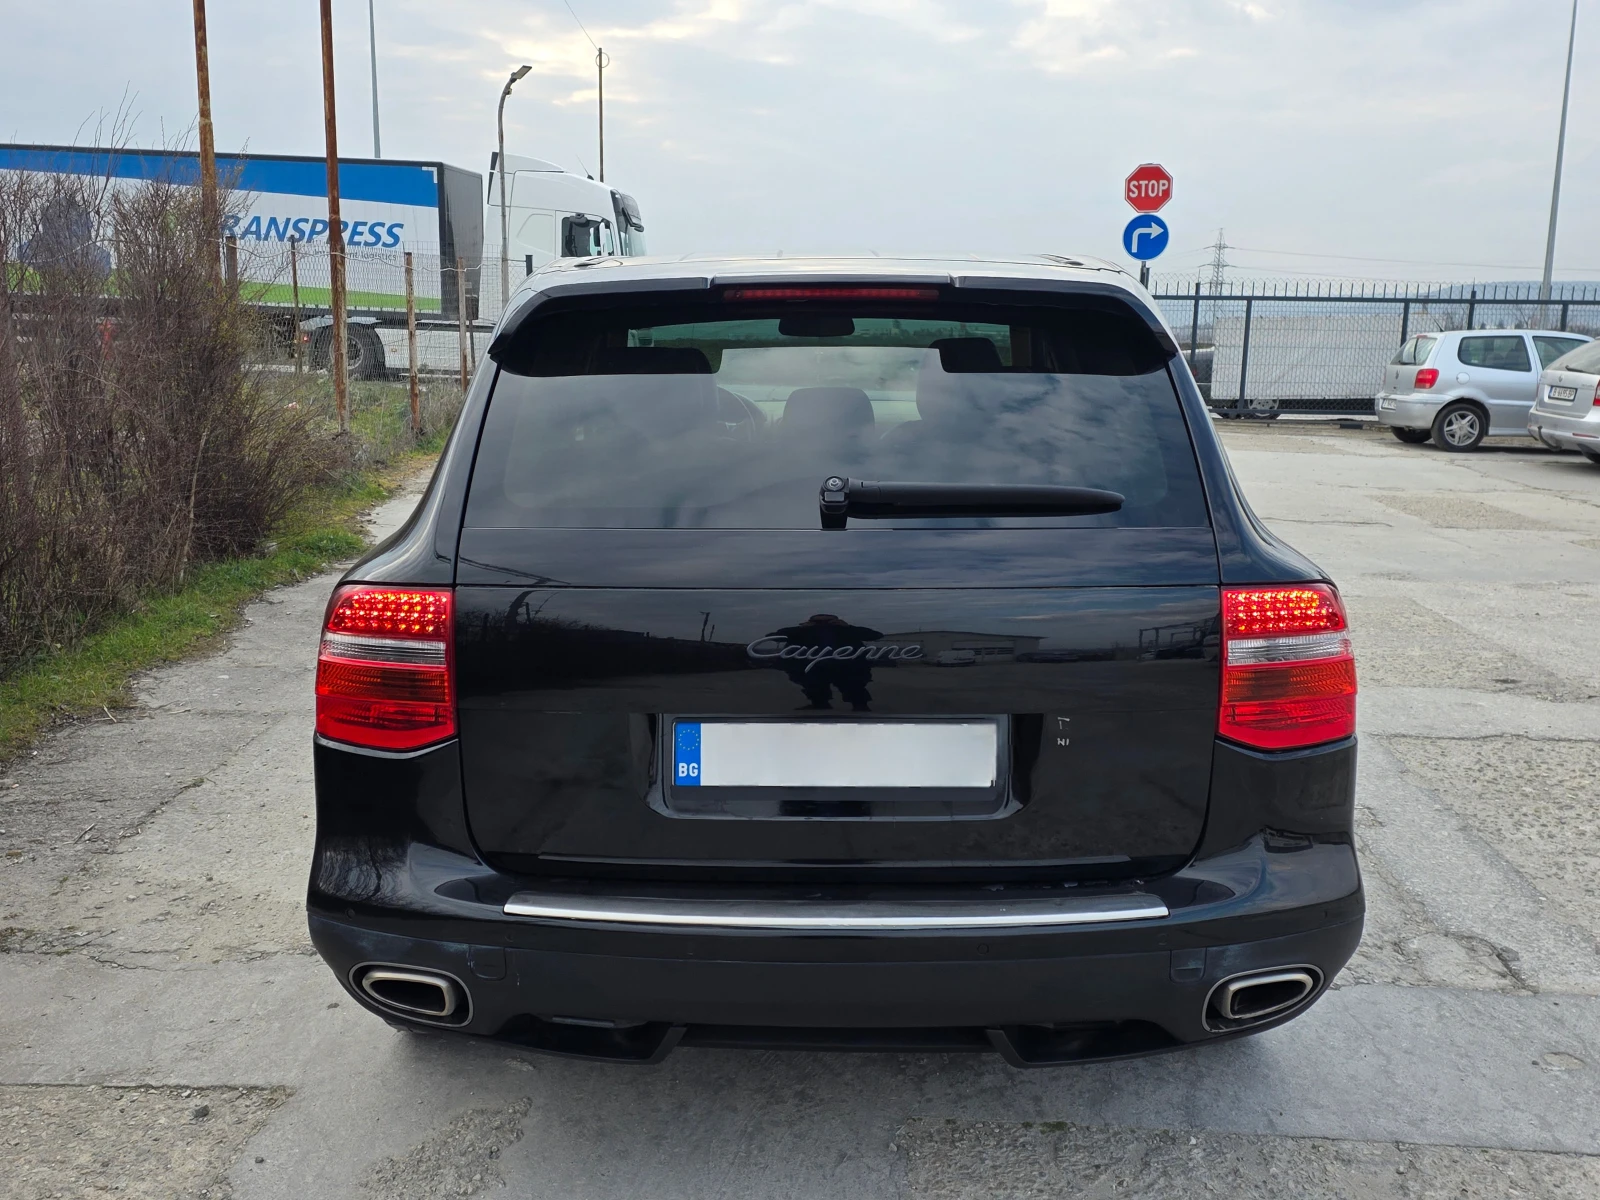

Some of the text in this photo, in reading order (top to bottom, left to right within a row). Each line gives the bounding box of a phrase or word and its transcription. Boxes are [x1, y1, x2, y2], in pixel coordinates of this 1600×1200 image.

[1129, 180, 1169, 198] STOP
[747, 635, 923, 673] Cayenne
[678, 762, 699, 777] BG
